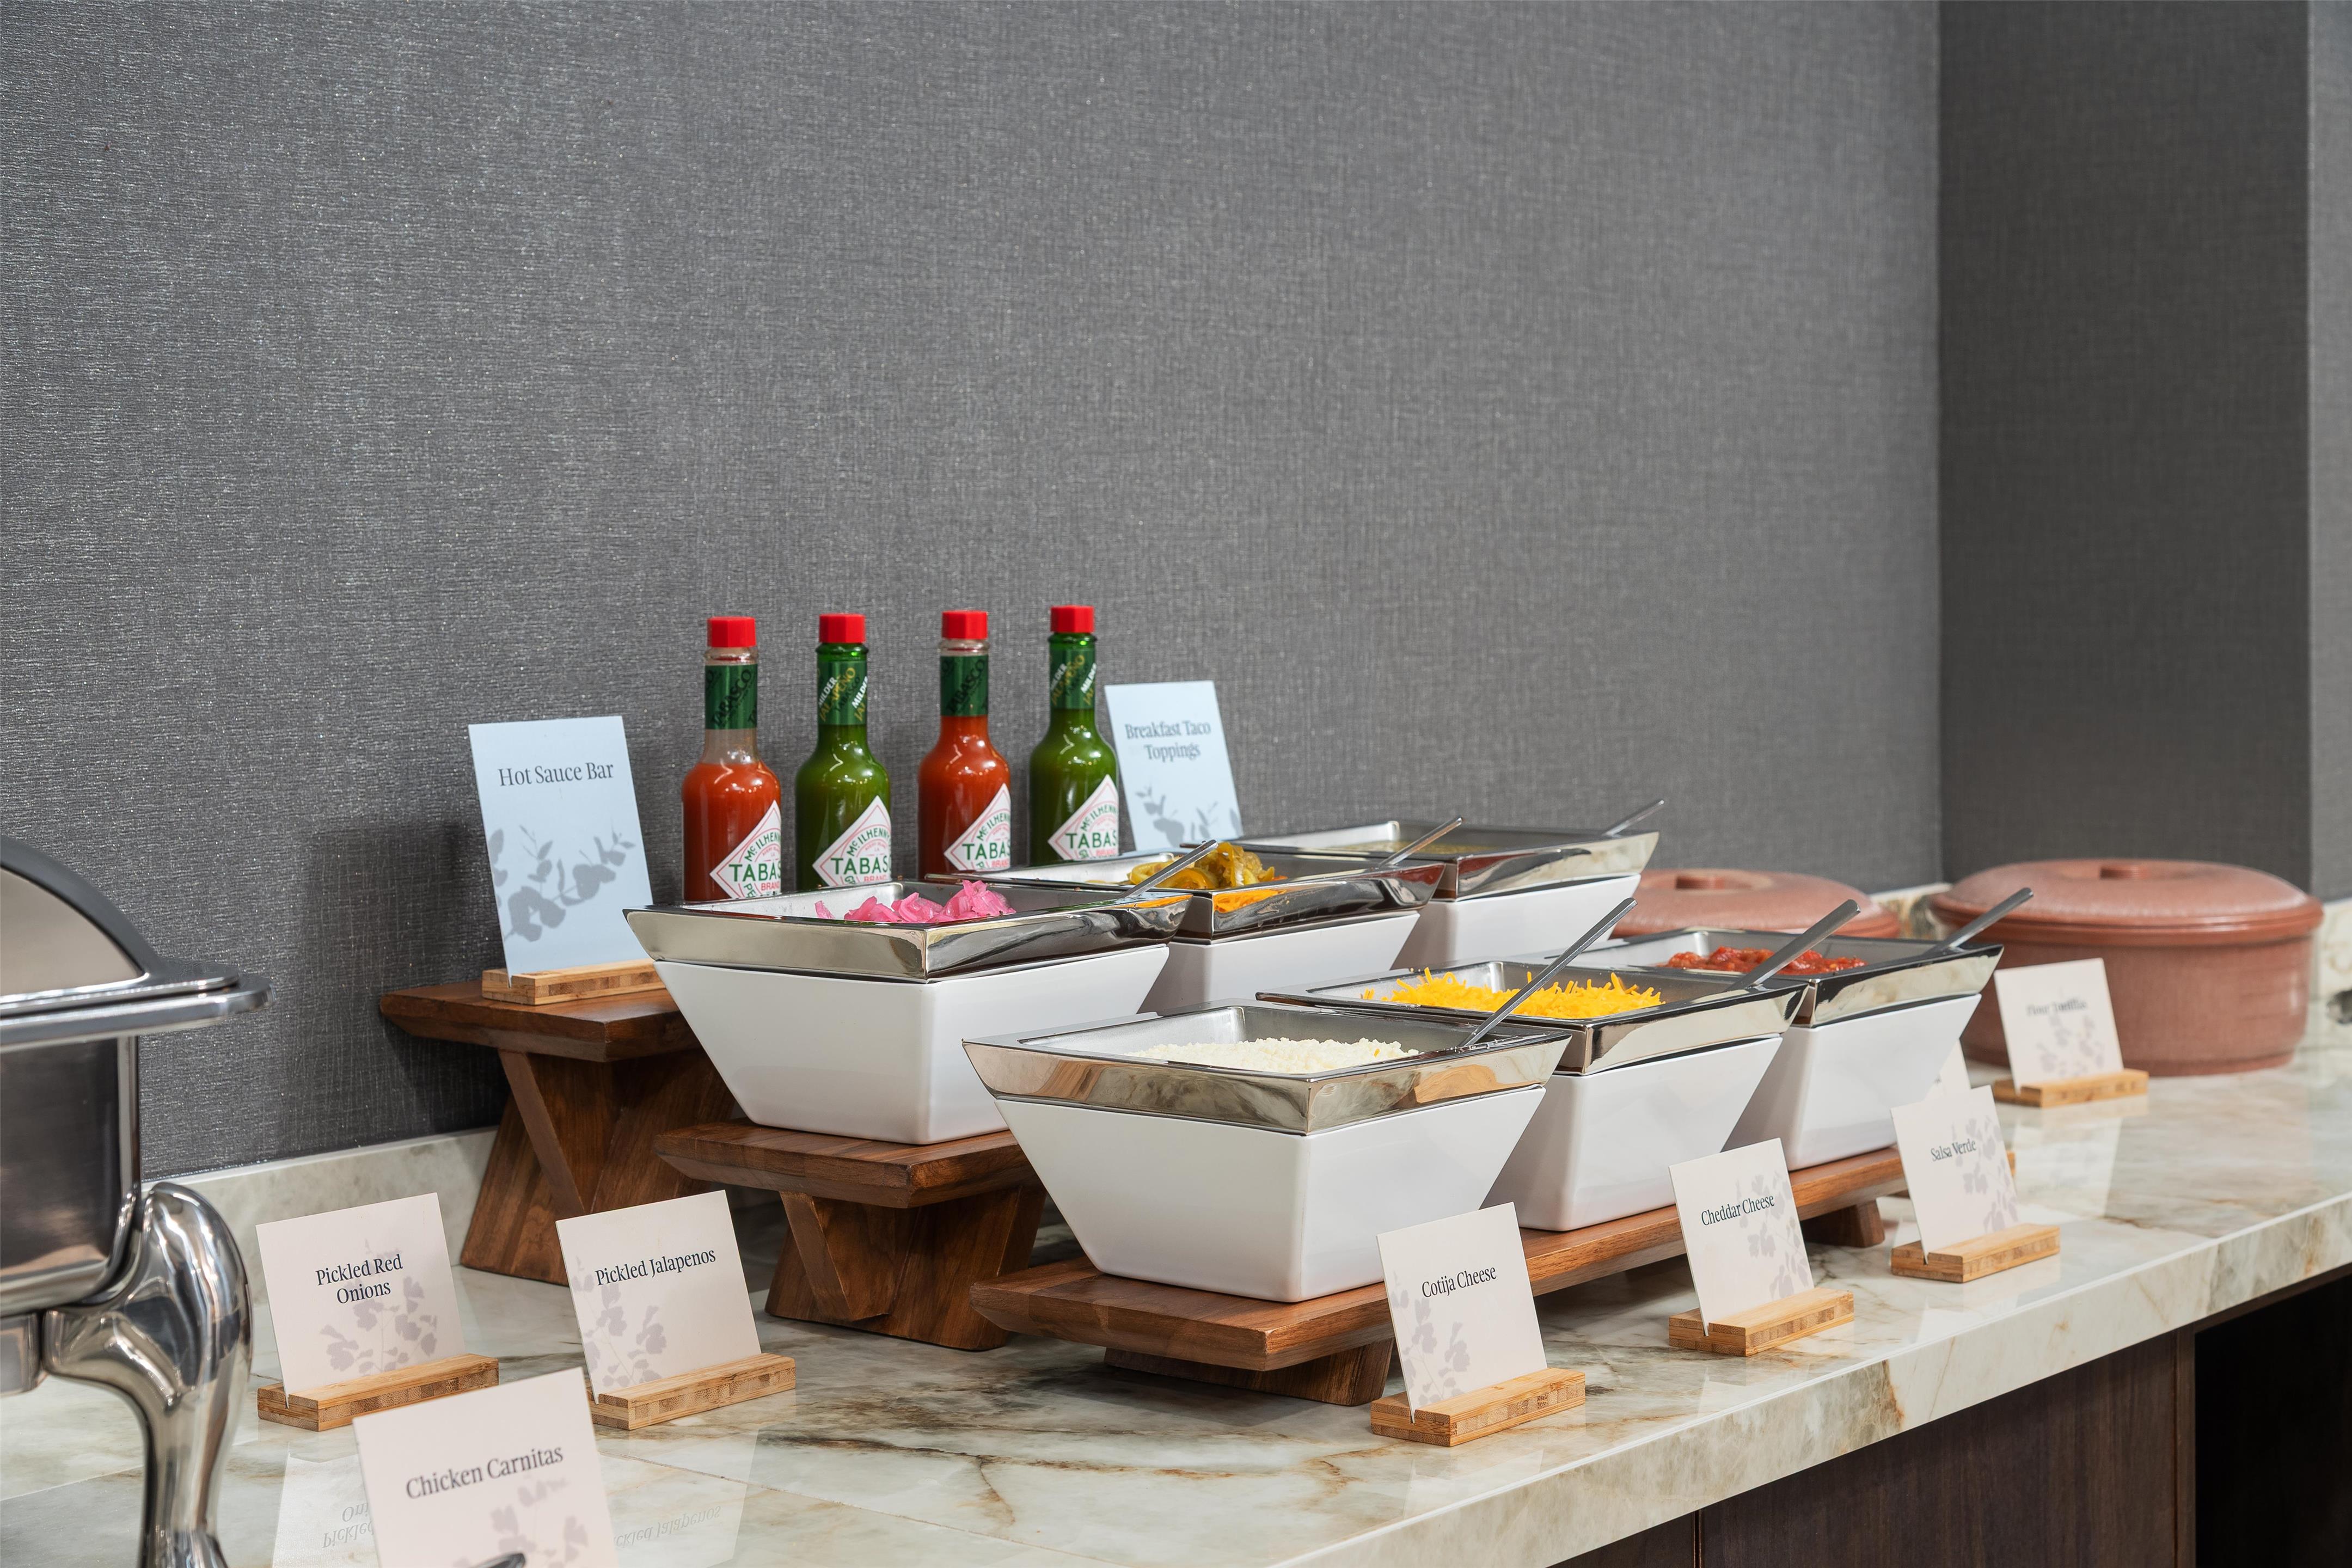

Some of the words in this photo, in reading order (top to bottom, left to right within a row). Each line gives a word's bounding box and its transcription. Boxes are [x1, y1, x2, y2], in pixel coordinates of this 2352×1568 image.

[1125, 721, 1181, 739] Breakfast
[1182, 720, 1211, 736] Taco
[1144, 743, 1201, 762] Toppings
[498, 768, 532, 786] Hot
[535, 765, 582, 783] Sauce
[586, 762, 614, 780] Bar
[831, 855, 891, 875] TABAS
[1931, 1147, 1952, 1161] Salsa
[1952, 1138, 1976, 1155] Verde
[1701, 1204, 1741, 1226] Cheddar
[1742, 1195, 1775, 1214] Cheese
[315, 1260, 372, 1286] Pickled
[373, 1253, 403, 1275] Red
[595, 1260, 648, 1286] Pickled
[648, 1250, 716, 1278] Jalapenos
[336, 1282, 391, 1304] Onions
[1422, 1275, 1456, 1297] Cotija
[1457, 1266, 1497, 1288] Cheese
[406, 1467, 483, 1499] Chicken
[487, 1444, 564, 1479] Carnitas
